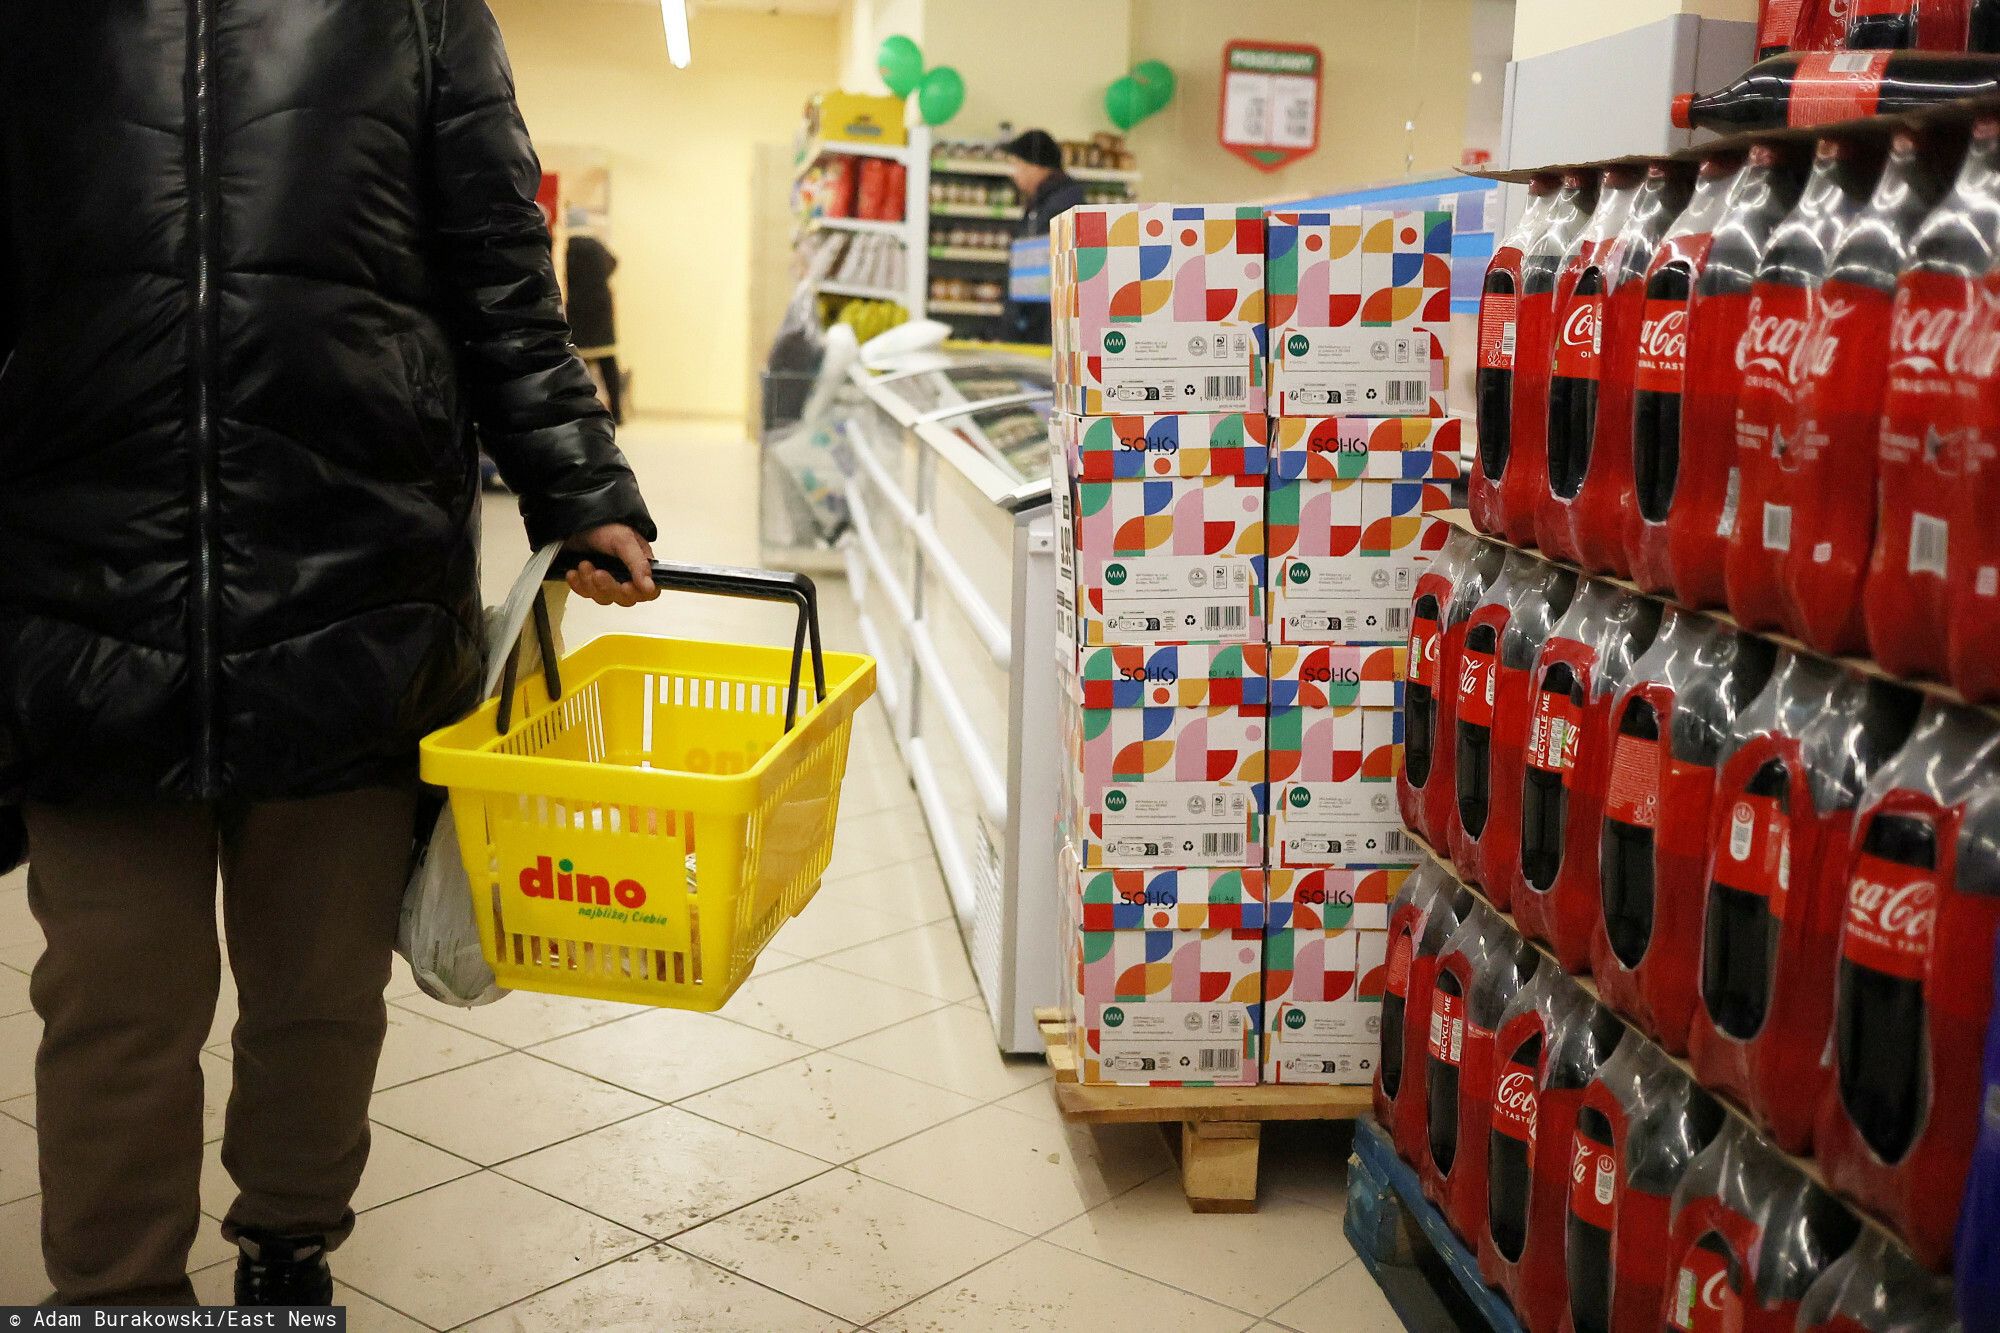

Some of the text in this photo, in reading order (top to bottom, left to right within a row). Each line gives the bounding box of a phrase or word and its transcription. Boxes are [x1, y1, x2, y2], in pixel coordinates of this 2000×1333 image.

[1106, 338, 1124, 346] MM
[1289, 342, 1308, 350] MM
[1107, 571, 1125, 579] MM
[1291, 569, 1309, 577] MM
[1536, 692, 1551, 768] RECYCLE ME
[1107, 797, 1125, 805] MM
[1291, 793, 1309, 801] MM
[518, 855, 647, 909] dino
[1105, 1013, 1123, 1021] MM
[1441, 995, 1452, 1061] RECYCLE ME
